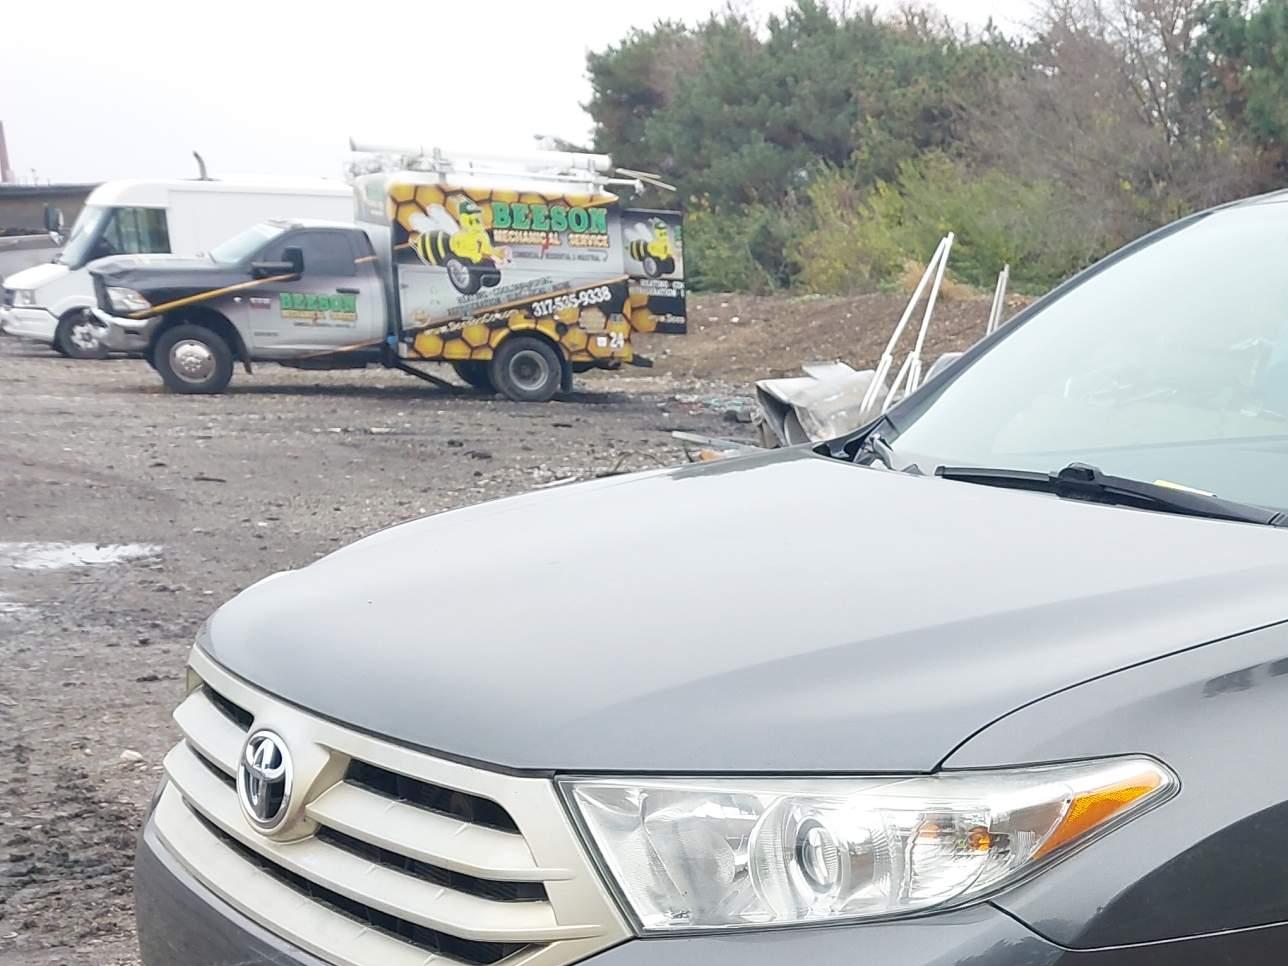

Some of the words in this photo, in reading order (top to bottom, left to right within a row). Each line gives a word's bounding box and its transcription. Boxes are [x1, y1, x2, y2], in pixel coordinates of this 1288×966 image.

[491, 201, 608, 233] BEESON
[494, 229, 561, 245] MECHANICAL
[568, 233, 609, 248] SERVICE
[610, 332, 624, 347] 24
